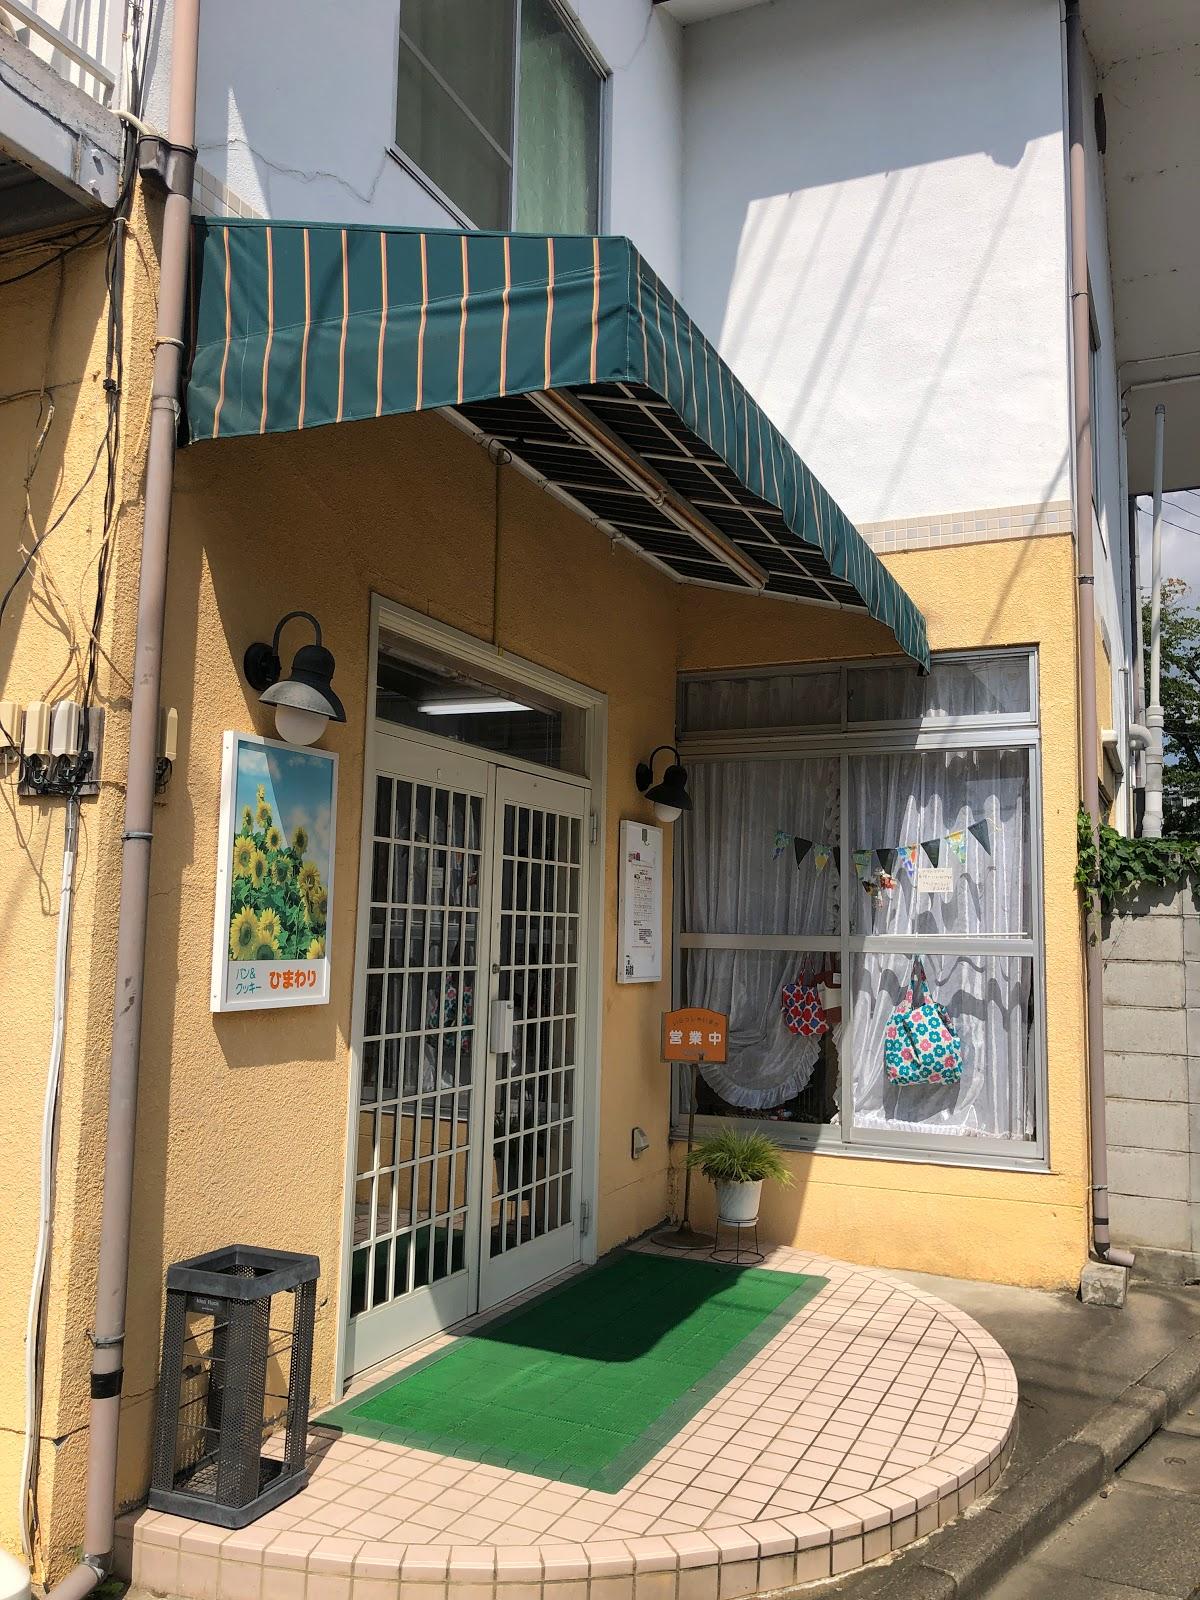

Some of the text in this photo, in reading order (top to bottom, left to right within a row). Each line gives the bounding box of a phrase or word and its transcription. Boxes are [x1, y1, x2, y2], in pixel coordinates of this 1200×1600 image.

[235, 967, 256, 980] パン&
[269, 969, 317, 989] ひまわり
[235, 982, 262, 996] クッキー
[669, 1029, 722, 1046] 営業中
